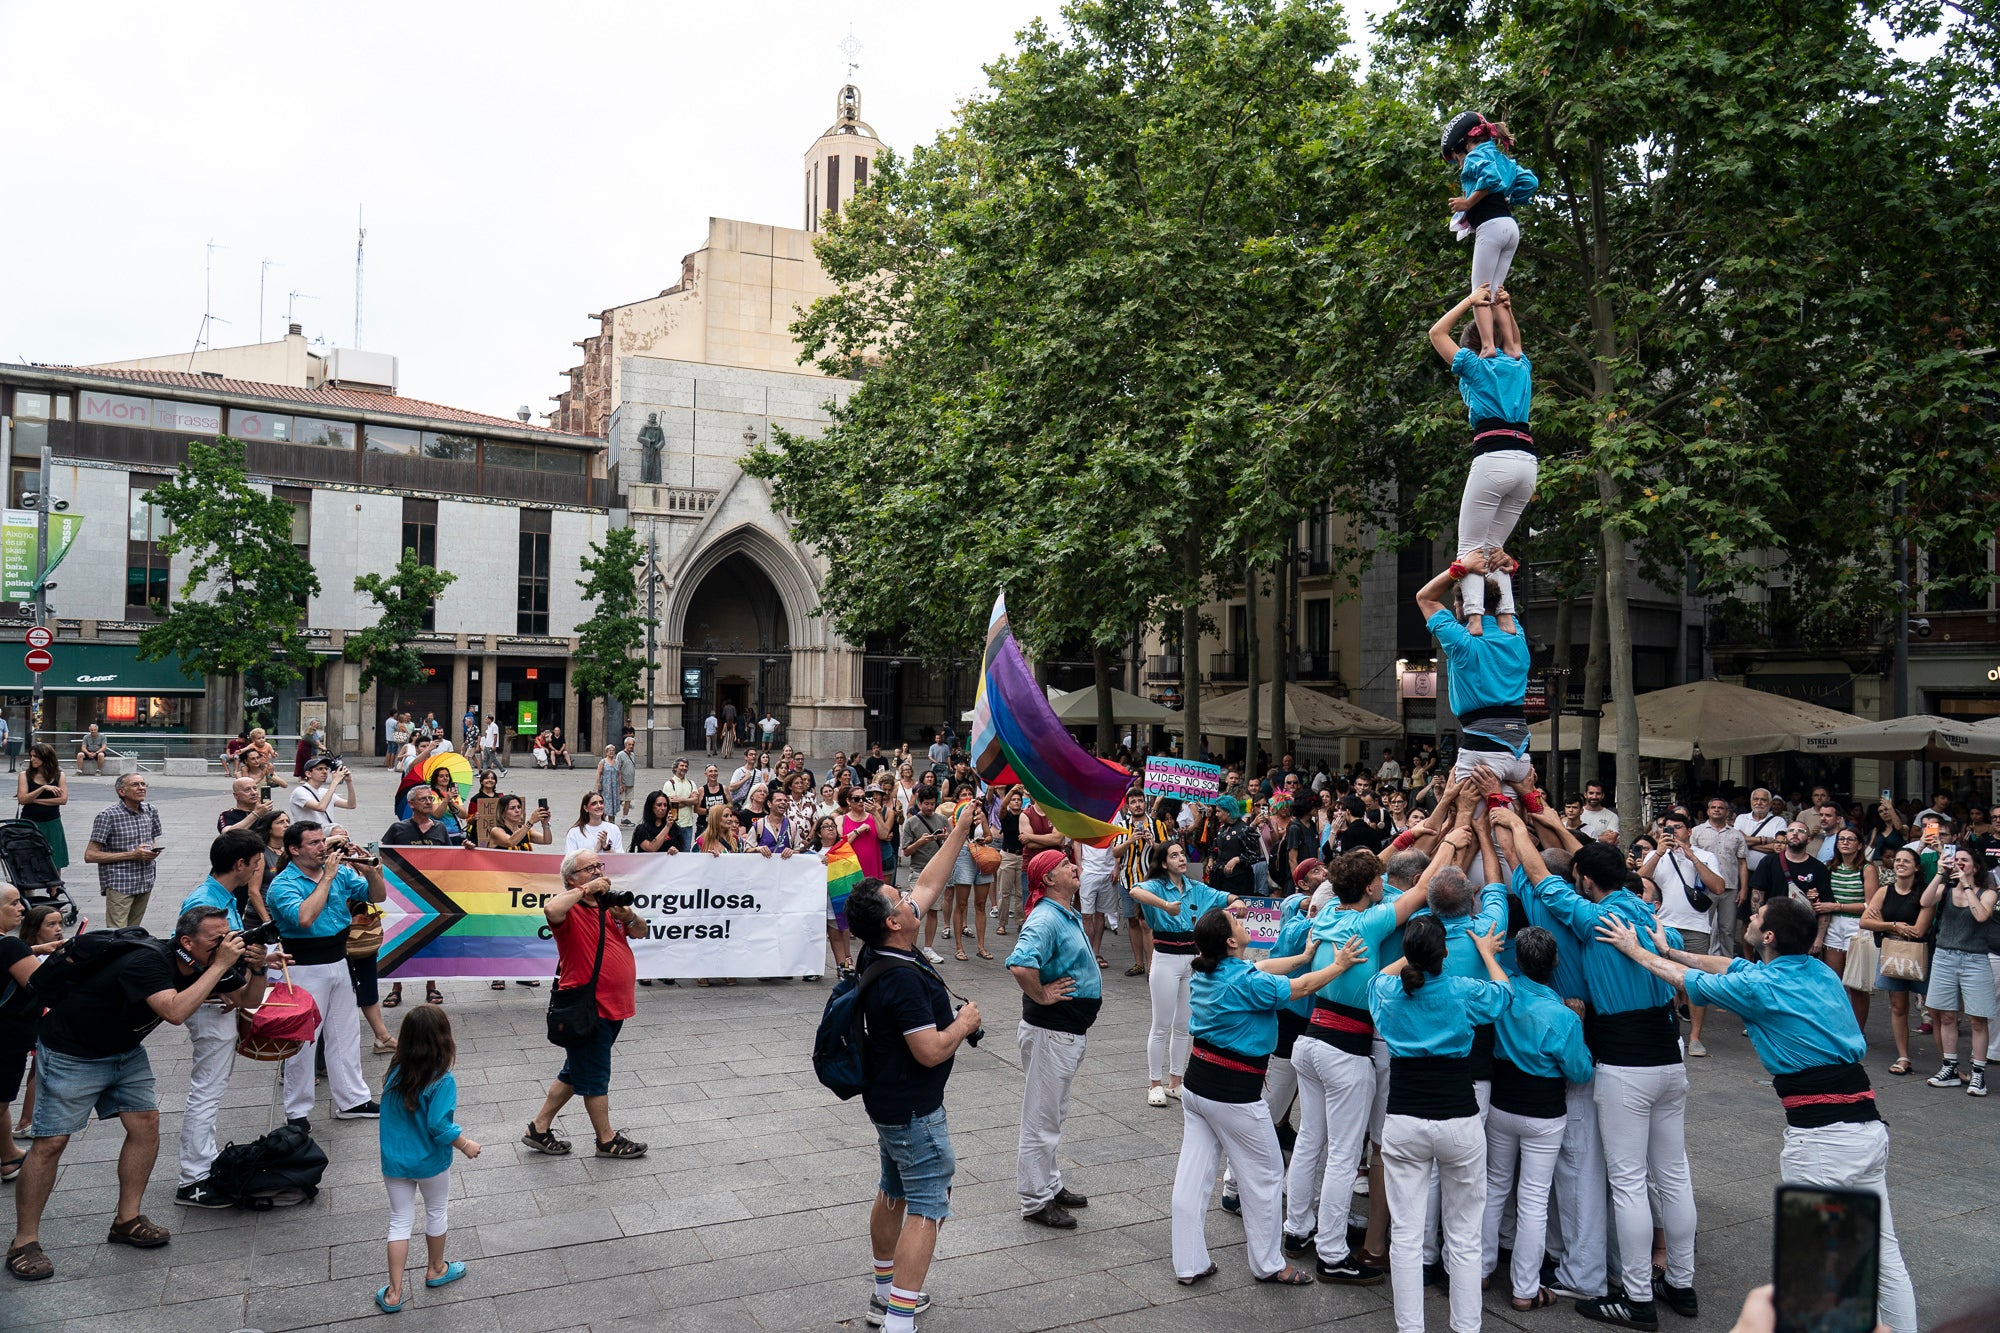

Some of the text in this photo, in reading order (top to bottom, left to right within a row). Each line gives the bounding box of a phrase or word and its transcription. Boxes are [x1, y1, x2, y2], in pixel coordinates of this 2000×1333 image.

[158, 410, 219, 429] Terrassa
[62, 518, 72, 550] rassa
[6, 563, 28, 571] baixa
[5, 580, 34, 588] patinet
[1148, 760, 1218, 780] LES NOSTRES
[1149, 772, 1182, 784] VIDES
[1185, 777, 1200, 788] NO
[1149, 782, 1213, 803] CAP DEBAT
[633, 888, 762, 915] orgullosa,
[1246, 911, 1272, 923] POR
[634, 919, 731, 940] iversa!
